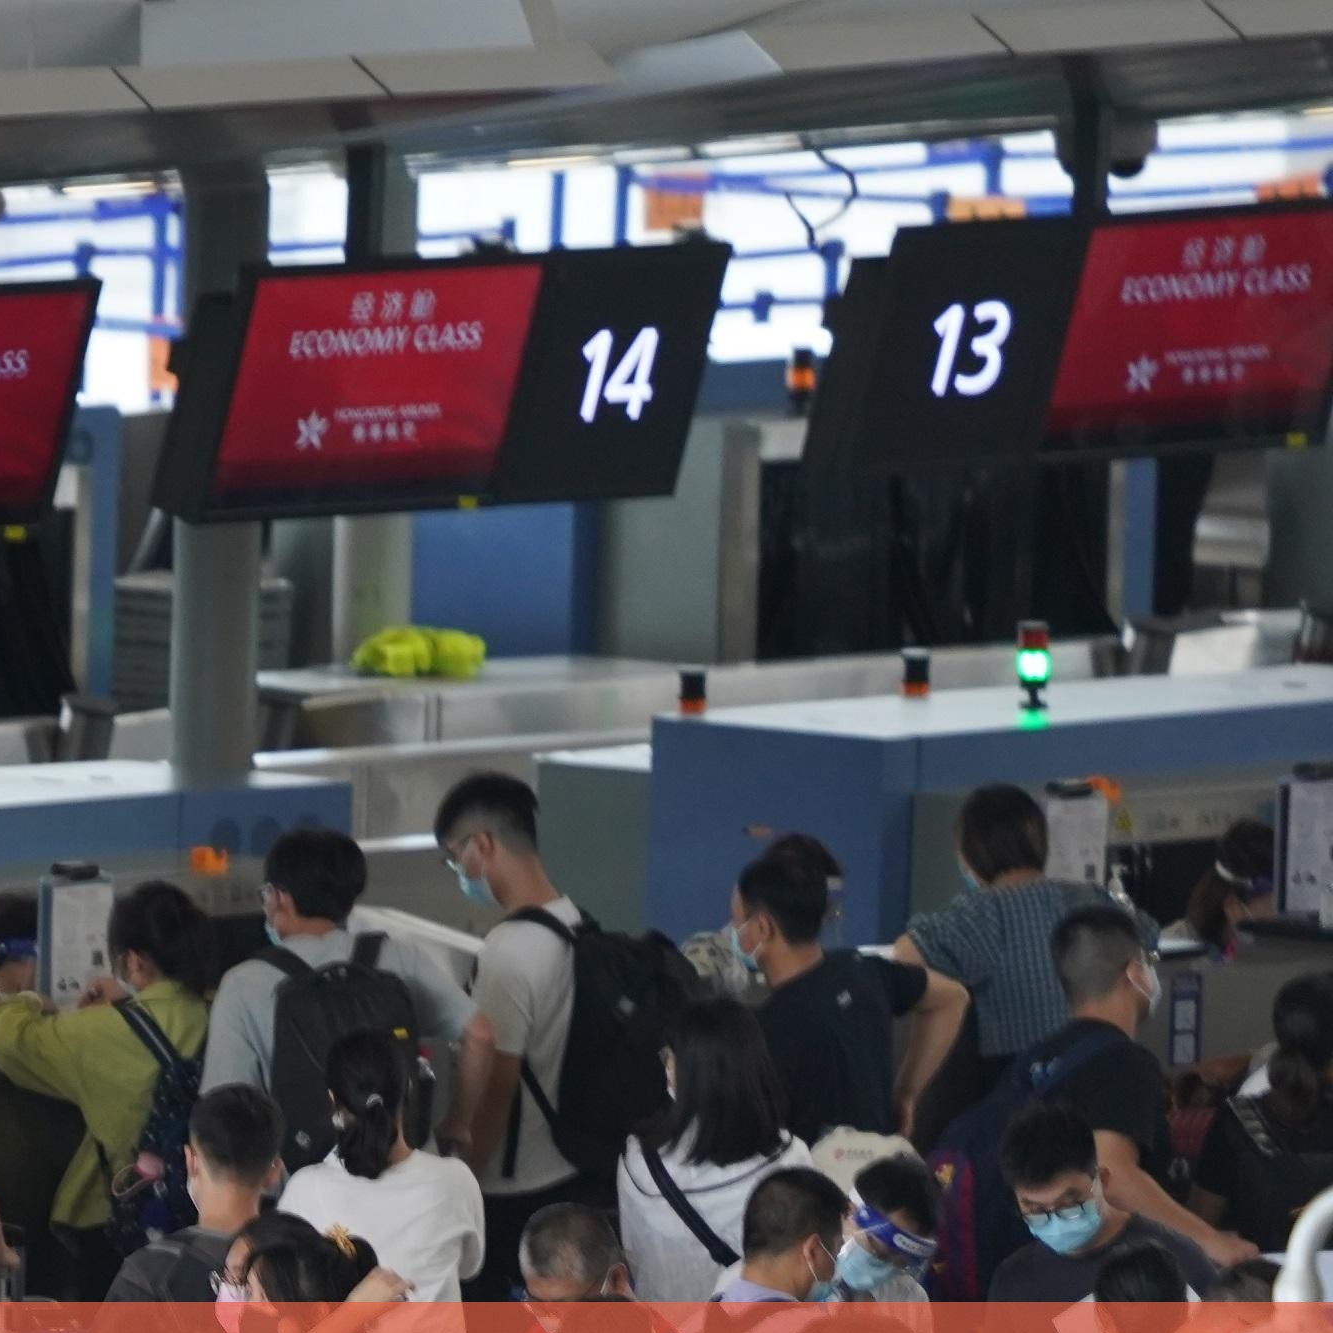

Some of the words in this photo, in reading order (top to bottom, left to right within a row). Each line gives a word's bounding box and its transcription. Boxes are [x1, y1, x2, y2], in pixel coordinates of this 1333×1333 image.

[1244, 263, 1312, 296] CLASS
[289, 324, 411, 360] ECONOMY
[414, 320, 484, 353] CLASS
[931, 300, 1011, 396] 13
[580, 327, 659, 423] 14
